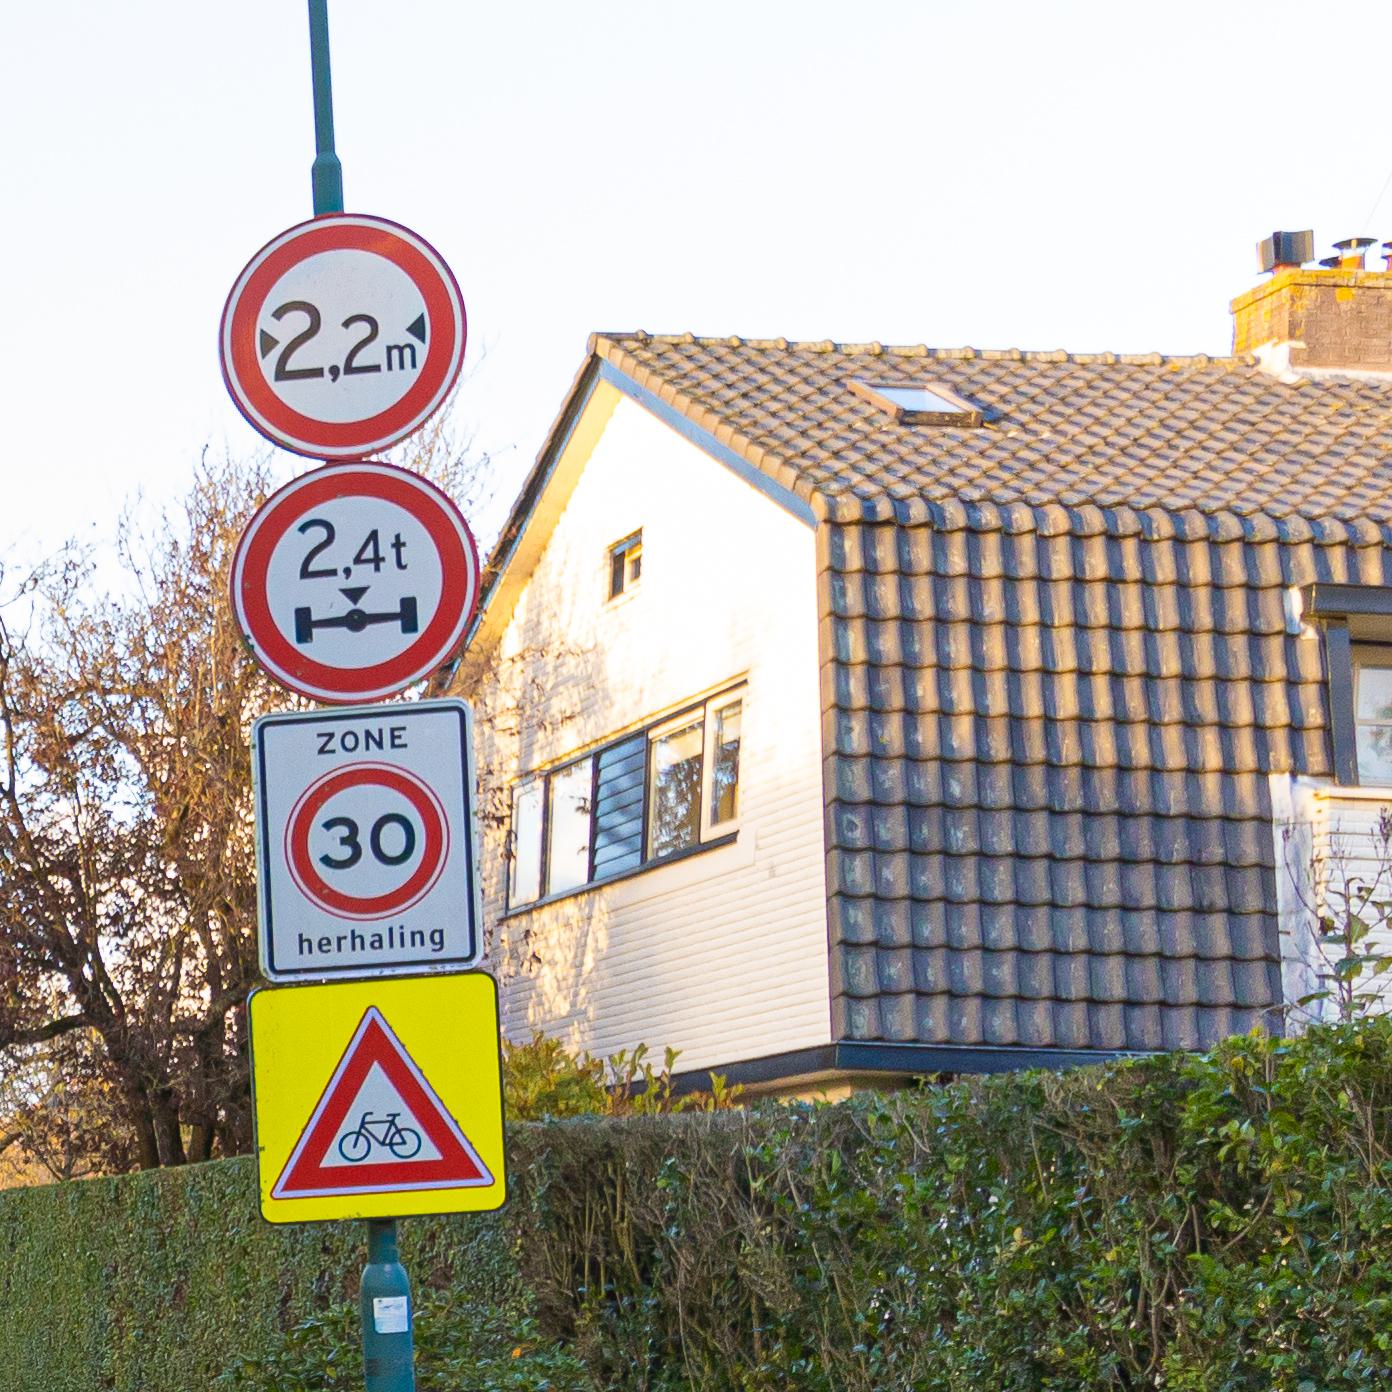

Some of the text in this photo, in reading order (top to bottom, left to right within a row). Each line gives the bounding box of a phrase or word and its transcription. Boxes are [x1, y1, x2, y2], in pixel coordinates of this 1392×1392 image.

[316, 726, 409, 755] ZONE
[319, 812, 416, 870] 30
[297, 925, 446, 956] herhaling
